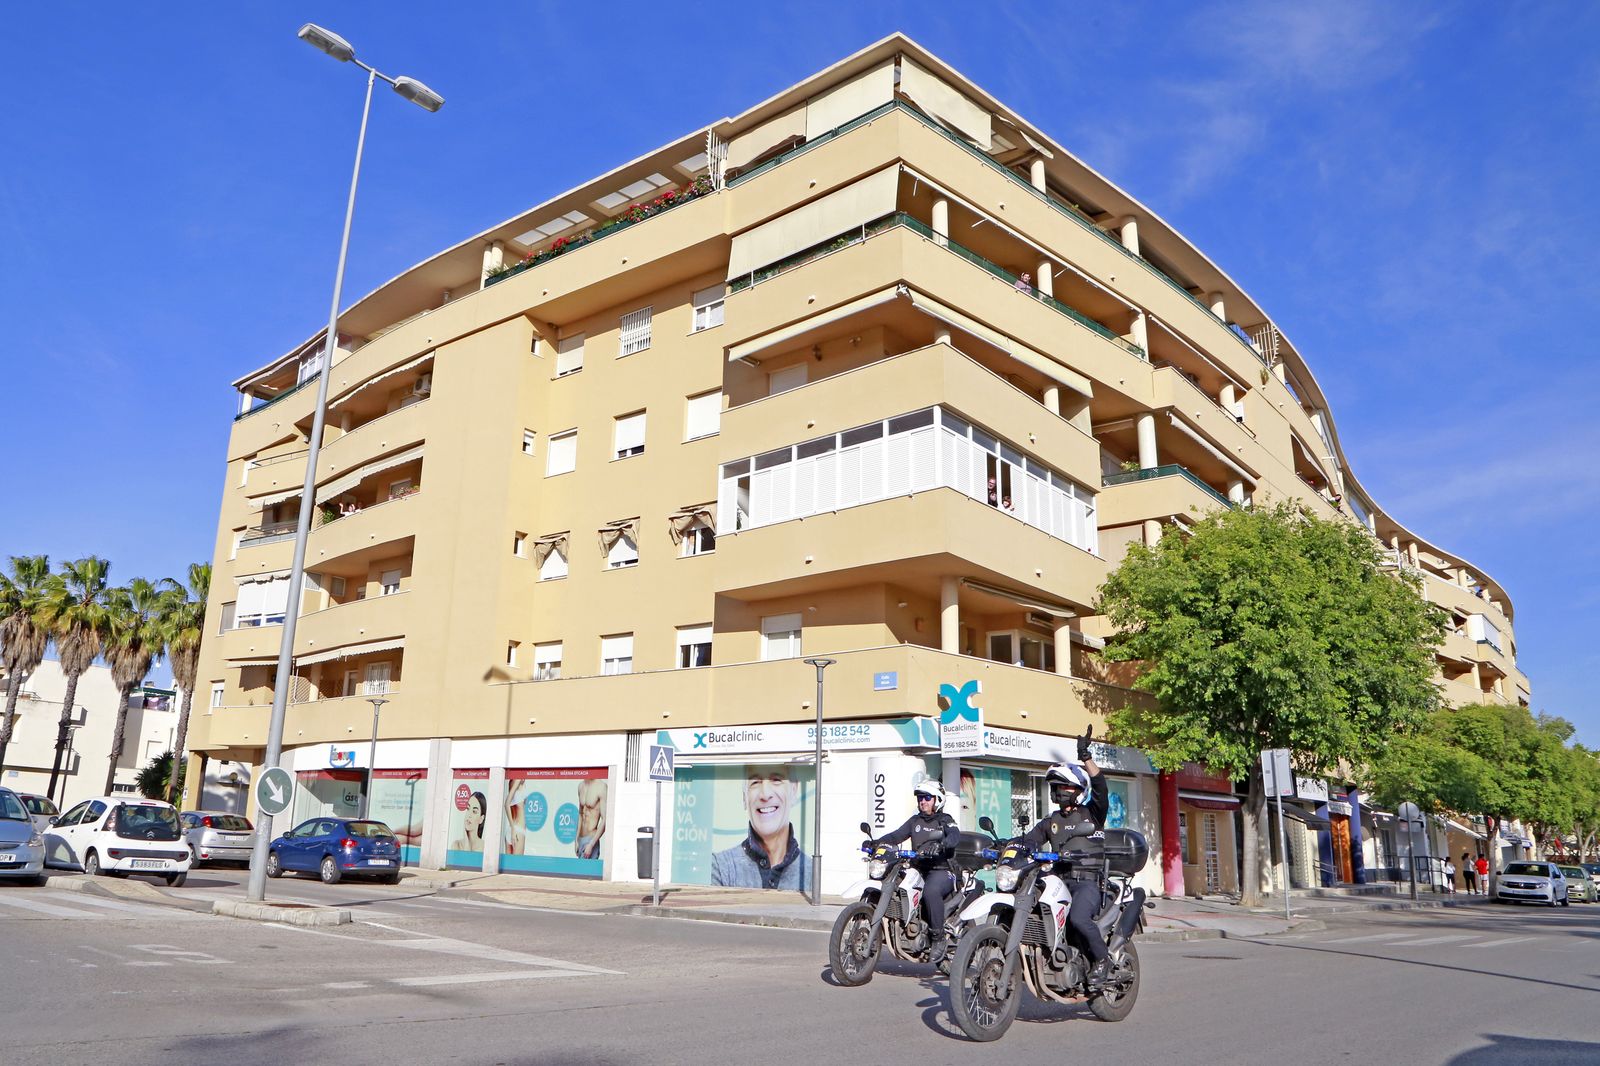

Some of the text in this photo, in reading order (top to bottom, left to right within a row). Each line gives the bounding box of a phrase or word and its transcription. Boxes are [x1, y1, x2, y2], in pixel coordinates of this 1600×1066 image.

[830, 726, 848, 737] 182
[849, 725, 870, 736] 542
[943, 723, 977, 733] Bucalclinic
[708, 730, 763, 743] Bucalclinic
[807, 737, 871, 745] ww.bucalclinic.com
[989, 732, 1031, 749] Bucalclinic
[677, 794, 697, 807] NO
[874, 773, 885, 828] SONRI
[677, 811, 694, 825] VA
[676, 824, 708, 842] CIÓN
